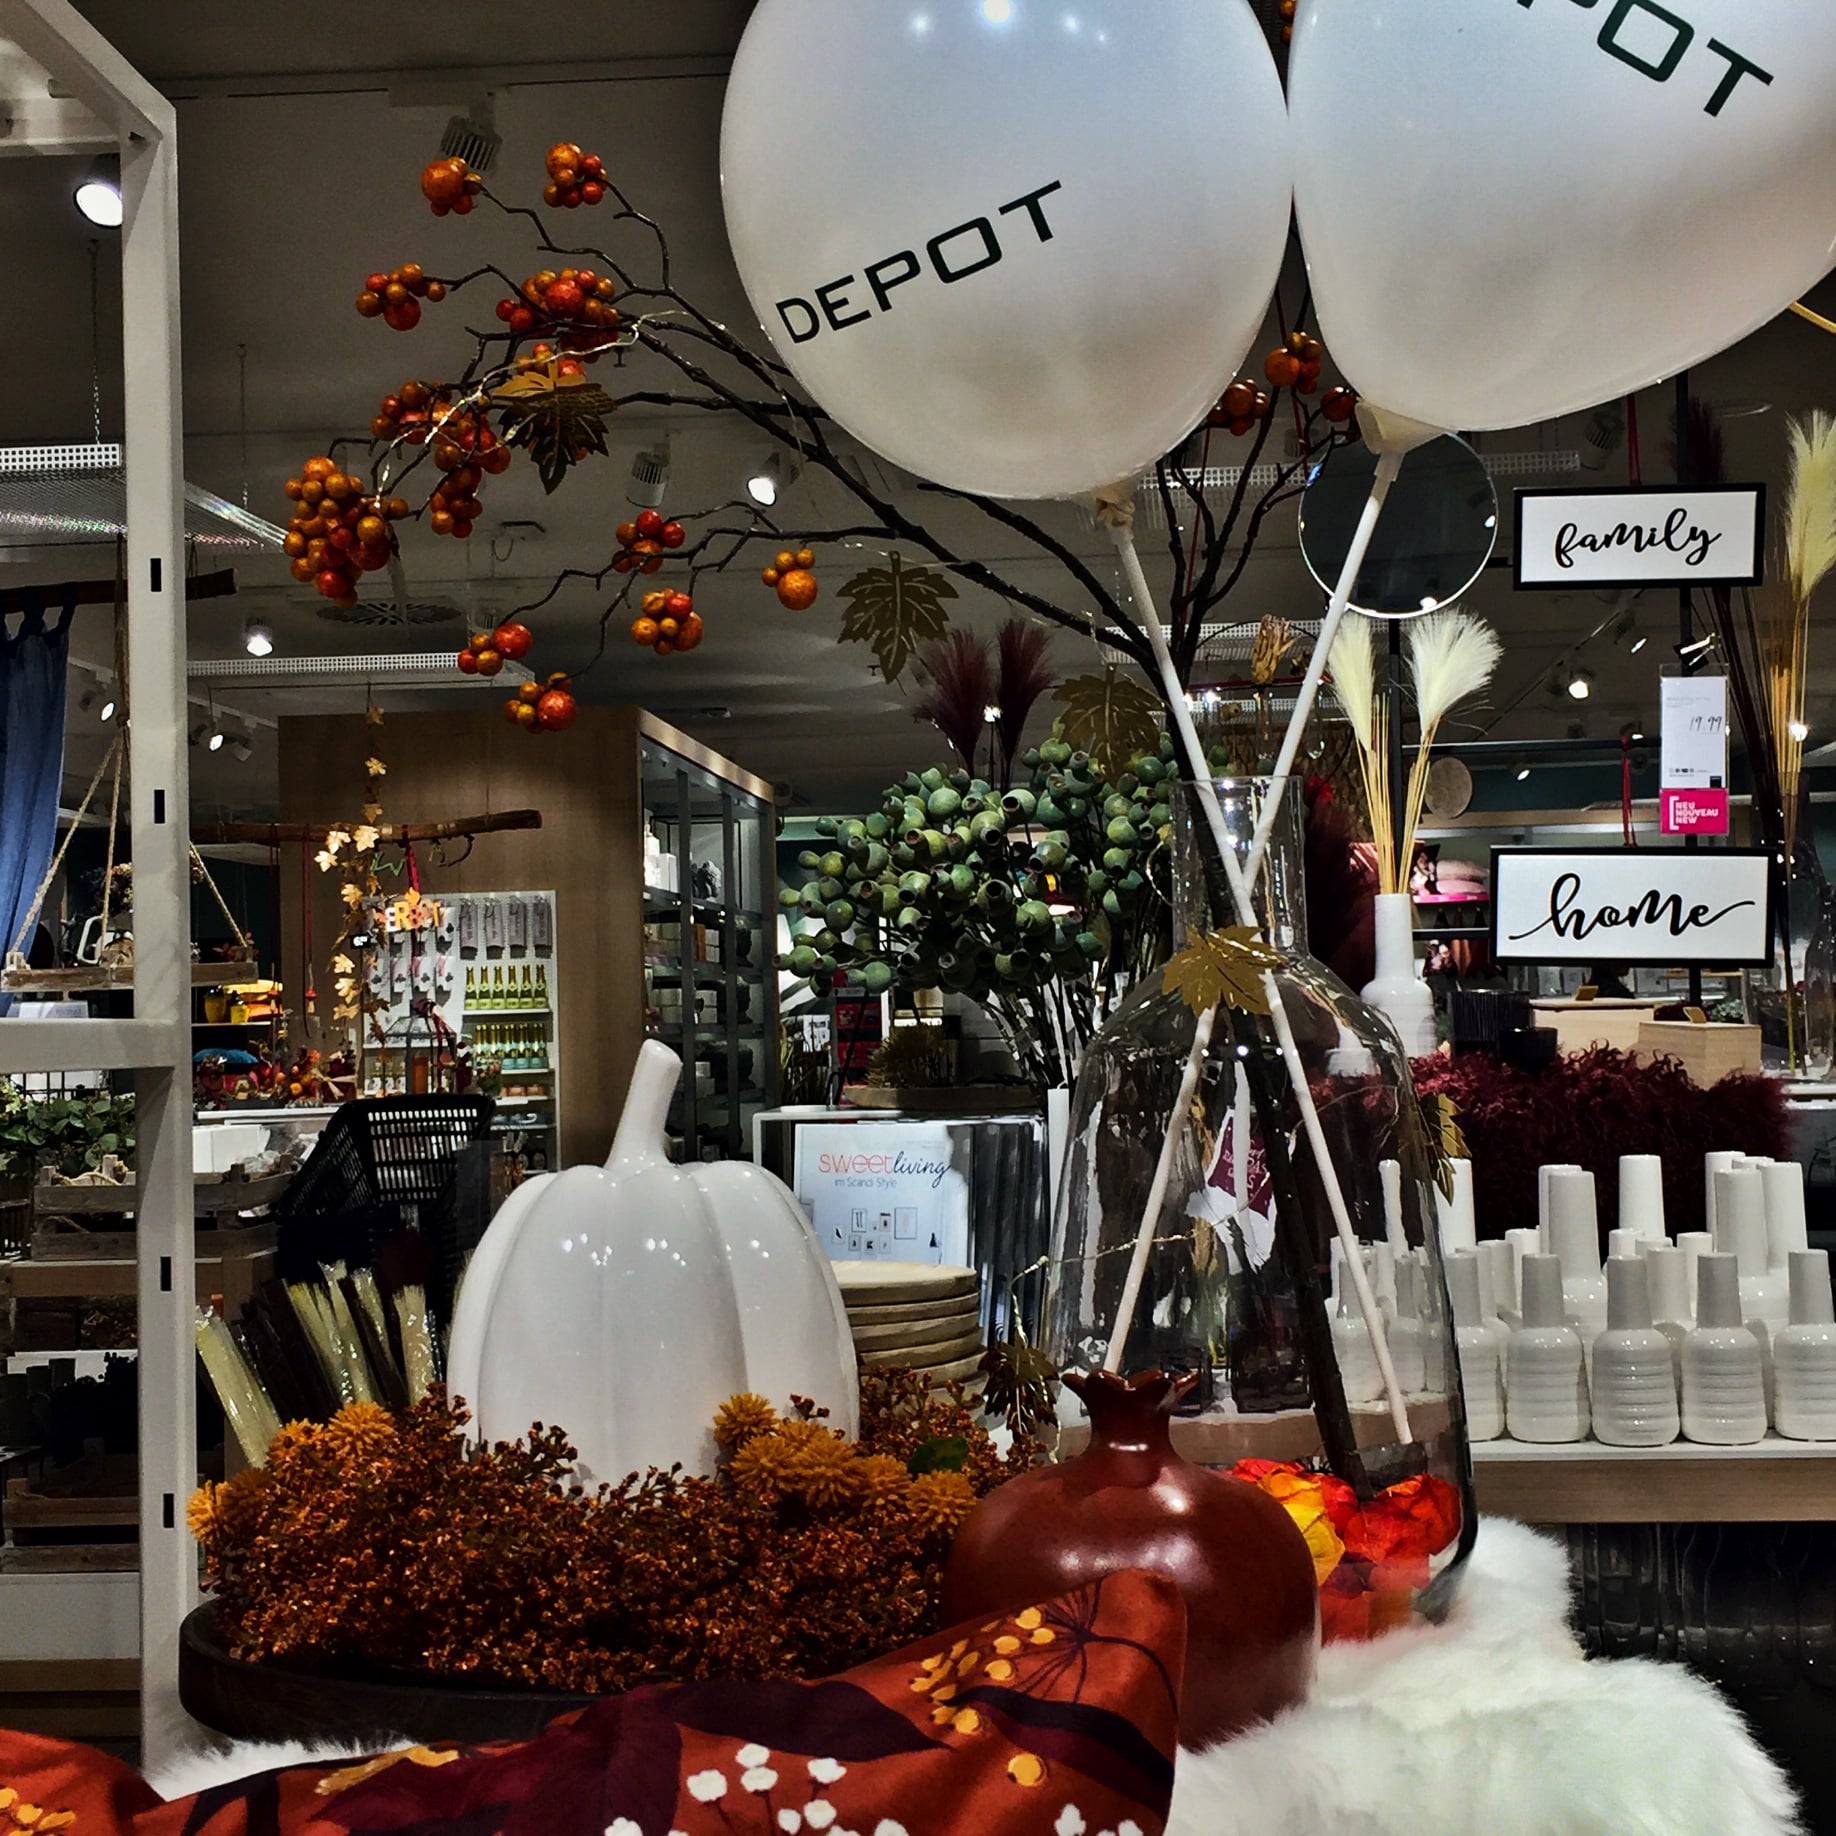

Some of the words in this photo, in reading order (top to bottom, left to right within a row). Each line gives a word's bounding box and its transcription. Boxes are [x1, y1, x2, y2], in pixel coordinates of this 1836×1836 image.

[776, 180, 1062, 343] DEPOT
[1554, 507, 1722, 568] family
[1675, 801, 1696, 810] NEU
[1675, 808, 1719, 817] NOUVEAU
[1675, 816, 1698, 824] NEW
[1508, 872, 1756, 940] home
